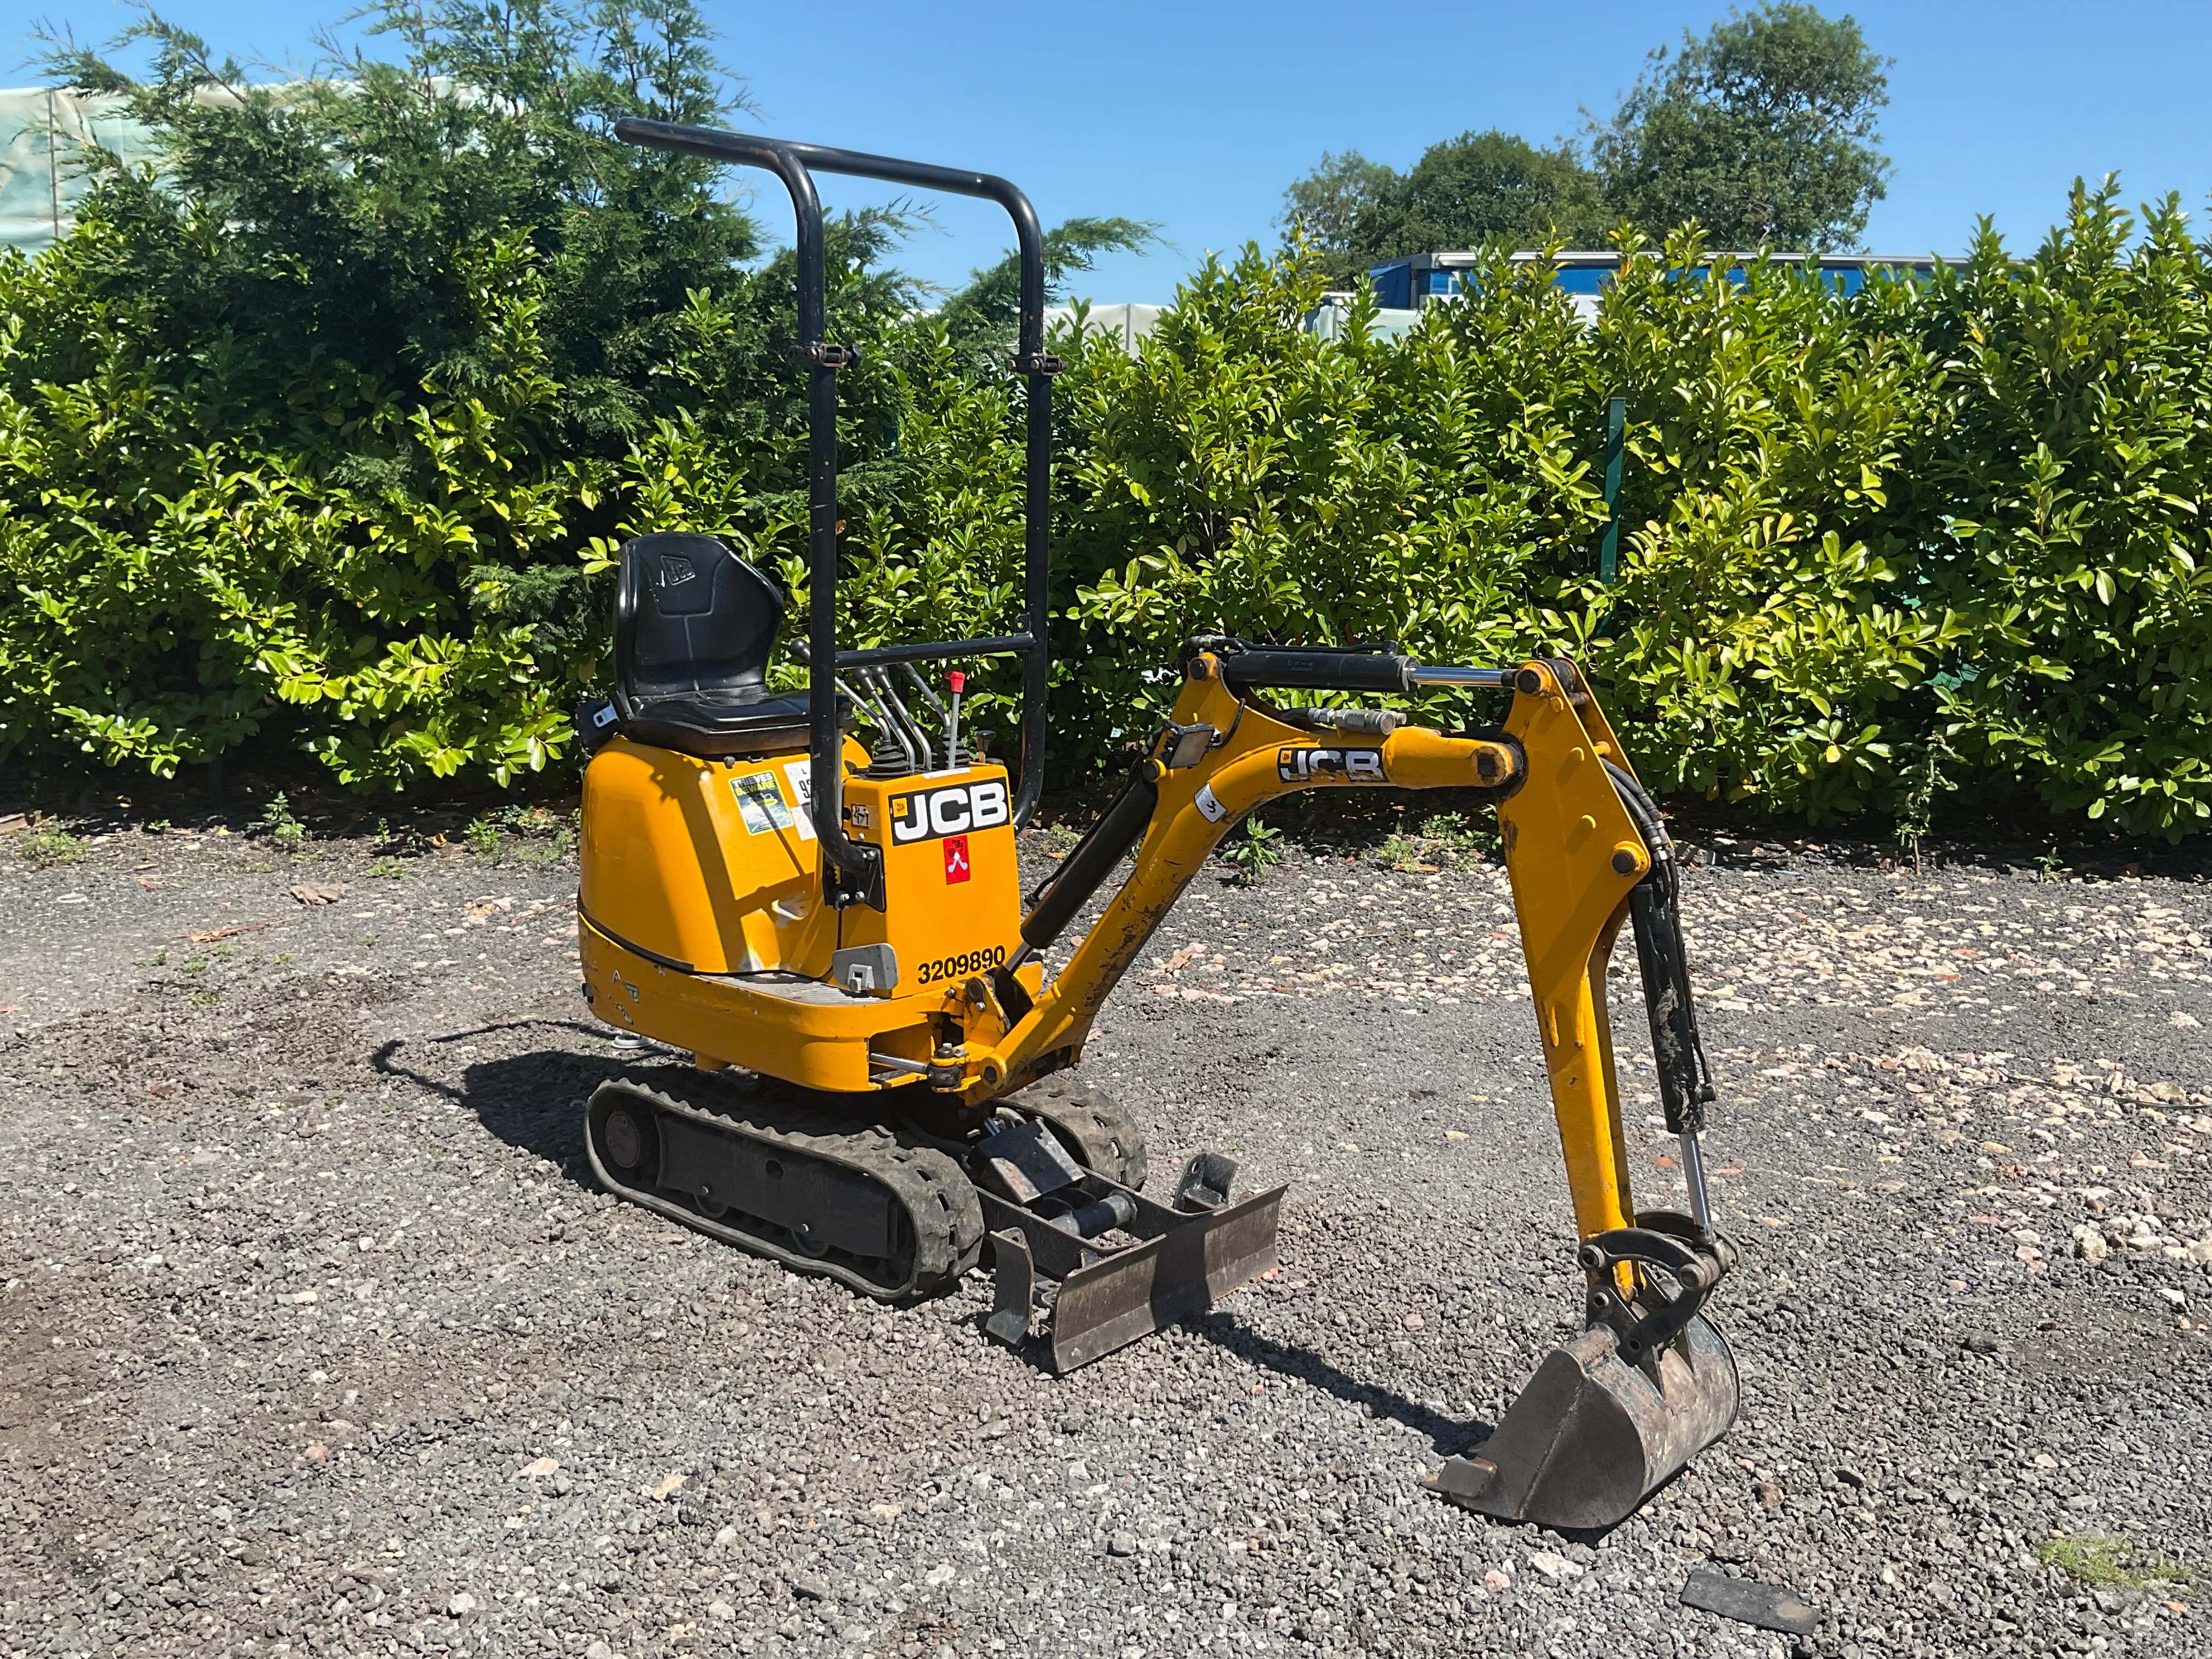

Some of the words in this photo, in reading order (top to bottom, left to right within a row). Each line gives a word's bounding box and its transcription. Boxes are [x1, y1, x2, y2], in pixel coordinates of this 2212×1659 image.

[732, 772, 774, 788] THIEVES
[1280, 750, 1384, 781] JCB
[735, 780, 776, 796] BEWARE
[894, 782, 1007, 840] JCB
[918, 945, 1006, 984] 3209890
